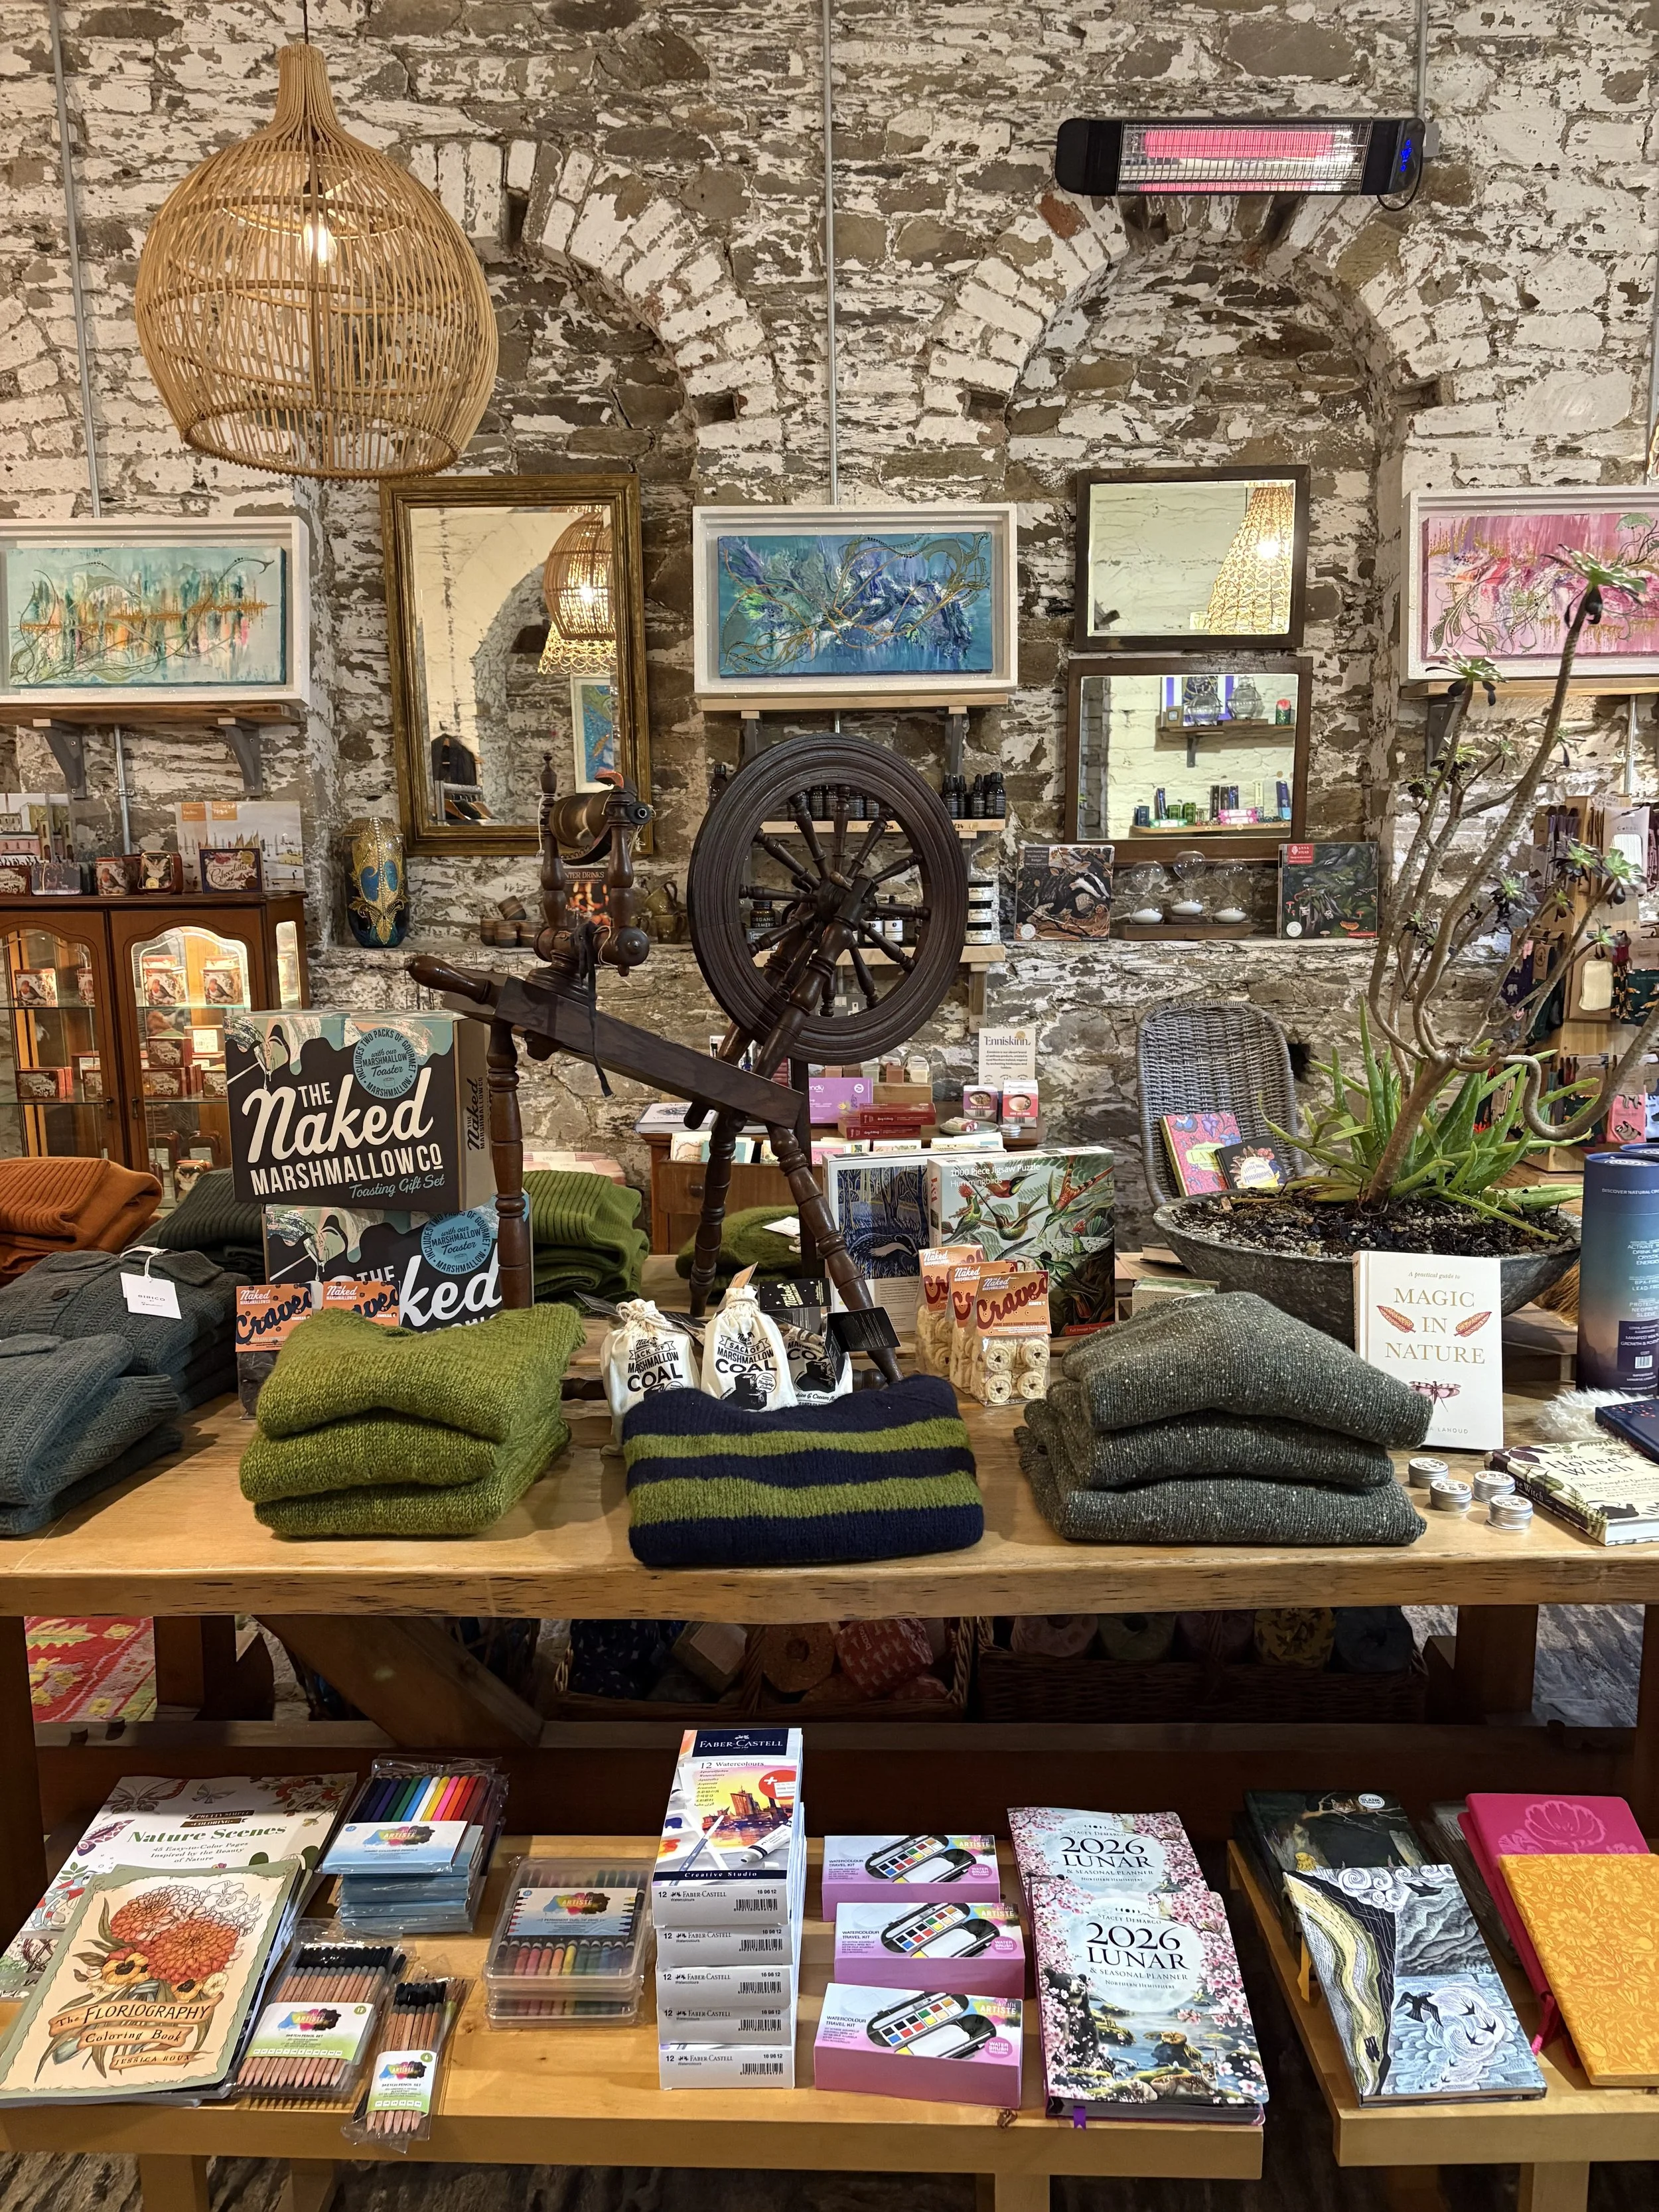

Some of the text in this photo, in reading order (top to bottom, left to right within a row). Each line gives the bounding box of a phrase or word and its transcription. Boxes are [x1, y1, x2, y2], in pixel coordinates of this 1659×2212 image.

[363, 1053, 407, 1067] MARSHMALLOW
[372, 1049, 384, 1057] with
[355, 1029, 416, 1096] INCLUDES TWO PACKS OF GOURMET MARSHMALLOW
[372, 1065, 403, 1076] Toaster
[298, 1082, 332, 1107] THE
[242, 1067, 433, 1163] Naked
[467, 1078, 480, 1151] Naked
[250, 1147, 413, 1195] MARSHMALLOW
[991, 1166, 1016, 1176] Jigsaw
[1017, 1163, 1041, 1173] Puzzle
[349, 1173, 445, 1199] Toasting Gift Set
[950, 1177, 1003, 1189] Hummingbirds
[432, 1228, 481, 1246] MARSHMALLOW
[441, 1227, 455, 1236] with
[423, 1211, 490, 1272] INCLUDES TWO OF GOURMET MARSHMALLOW
[441, 1241, 476, 1255] Toaster
[923, 1250, 948, 1261] Naked
[954, 1266, 980, 1277] Naked
[983, 1276, 1011, 1287] Naked
[240, 1290, 270, 1301] Naked
[326, 1286, 358, 1296] Naked
[1393, 1288, 1475, 1307] MAGIC
[977, 1271, 1048, 1330] Craved
[1422, 1317, 1447, 1333] IN
[717, 1347, 774, 1364] MARSHMALLOW
[1385, 1342, 1485, 1364] NATURE
[715, 1359, 777, 1373] COAL
[628, 1363, 683, 1392] COAL
[1546, 1457, 1621, 1469] House
[1559, 1464, 1635, 1476] Witch
[1524, 1481, 1544, 1501] Witch
[127, 1826, 287, 1842] Nature Scenes
[166, 1844, 223, 1852] Easy-to-Color
[1060, 1836, 1145, 1854] 2026
[1061, 1854, 1155, 1868] LUNAR
[1086, 1922, 1181, 1951] 2026
[1086, 1946, 1190, 1970] LUNAR
[1100, 1968, 1144, 1978] SEASONAL
[55, 2004, 210, 2026] The FLORIOGRAPHY
[980, 2005, 1017, 2015] ARTISTE
[85, 2029, 182, 2043] Coloring Book
[114, 2057, 157, 2066] JESSICA
